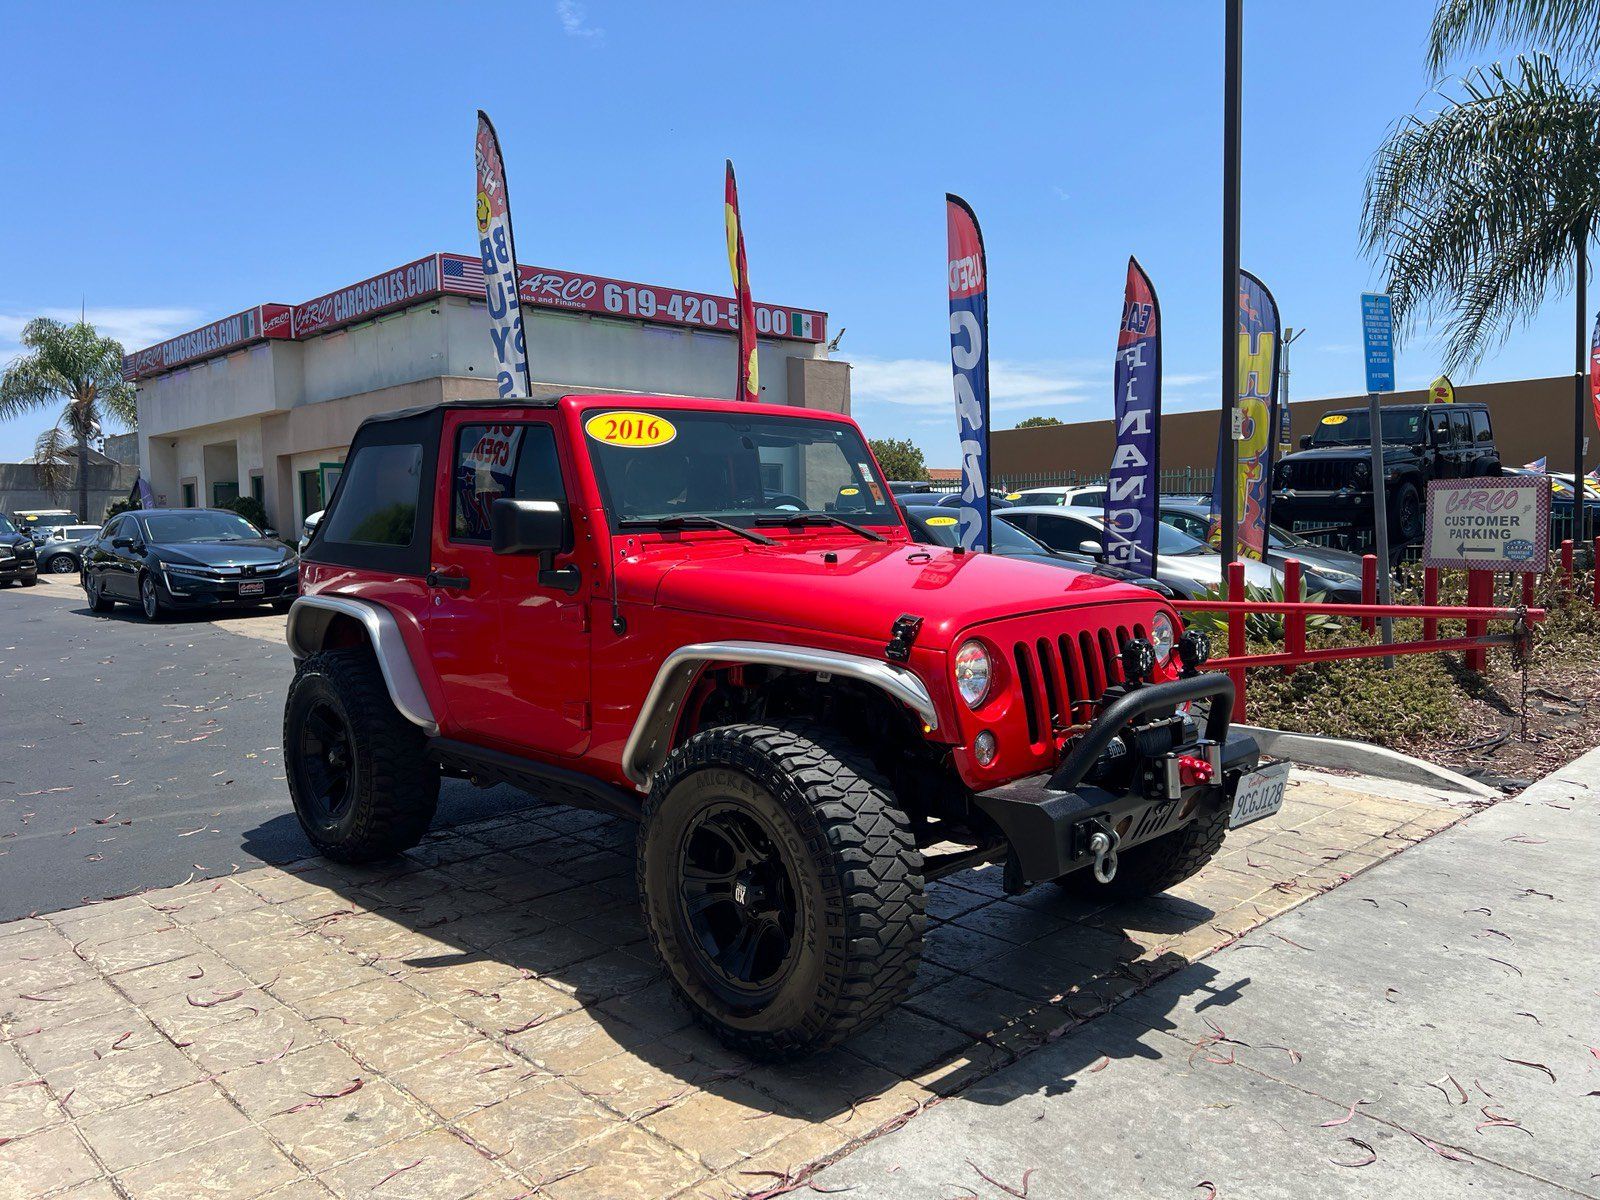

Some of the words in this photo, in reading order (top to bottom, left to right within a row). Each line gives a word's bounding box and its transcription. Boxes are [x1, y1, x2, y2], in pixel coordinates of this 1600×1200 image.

[295, 297, 333, 331] CARCO
[333, 258, 438, 322] CARCOSALES.COM
[517, 268, 597, 301] ARCO
[603, 282, 788, 335] 619-420-500
[520, 294, 536, 302] ales
[555, 298, 587, 308] Finance
[263, 312, 290, 330] CARCO
[162, 317, 242, 366] CARCOSALES.COM
[605, 419, 661, 440] 2016
[1445, 489, 1519, 514] CARCO
[1444, 515, 1520, 527] CUSTOMER
[1449, 528, 1512, 540] PARKING
[1234, 782, 1284, 819] 9CGJ128
